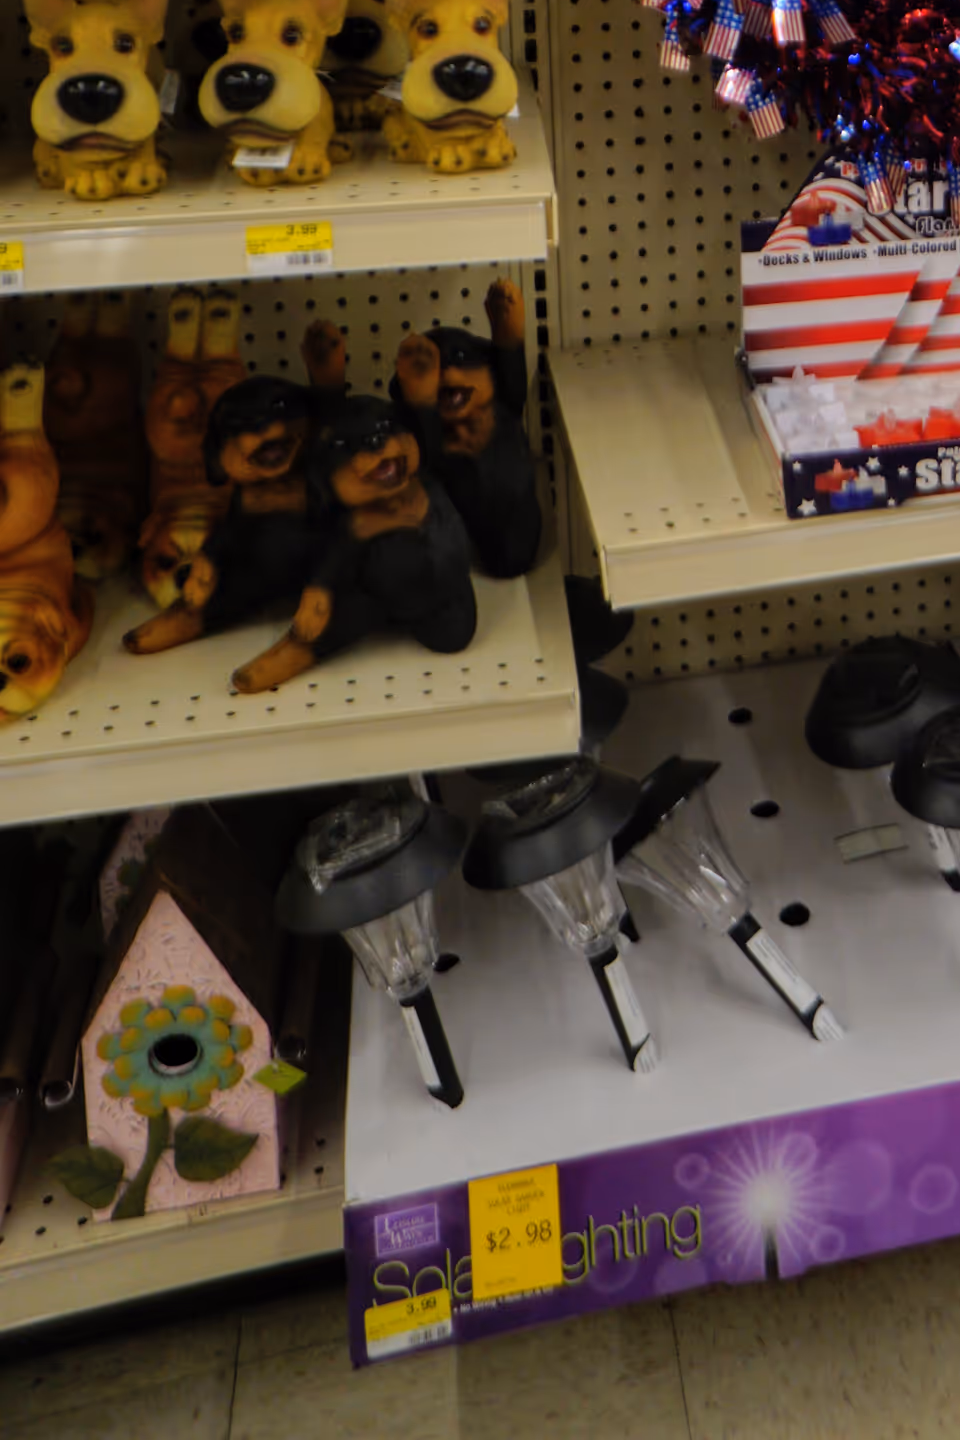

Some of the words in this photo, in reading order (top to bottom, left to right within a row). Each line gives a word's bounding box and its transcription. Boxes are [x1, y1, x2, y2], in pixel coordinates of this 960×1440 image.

[763, 252, 800, 267] Decks
[802, 252, 810, 263] &
[813, 247, 868, 262] Windows
[877, 241, 957, 257] Multi-Colored
[486, 1219, 552, 1253] $2.98
[373, 1247, 473, 1302] Sola
[406, 1295, 437, 1314] 3.99
